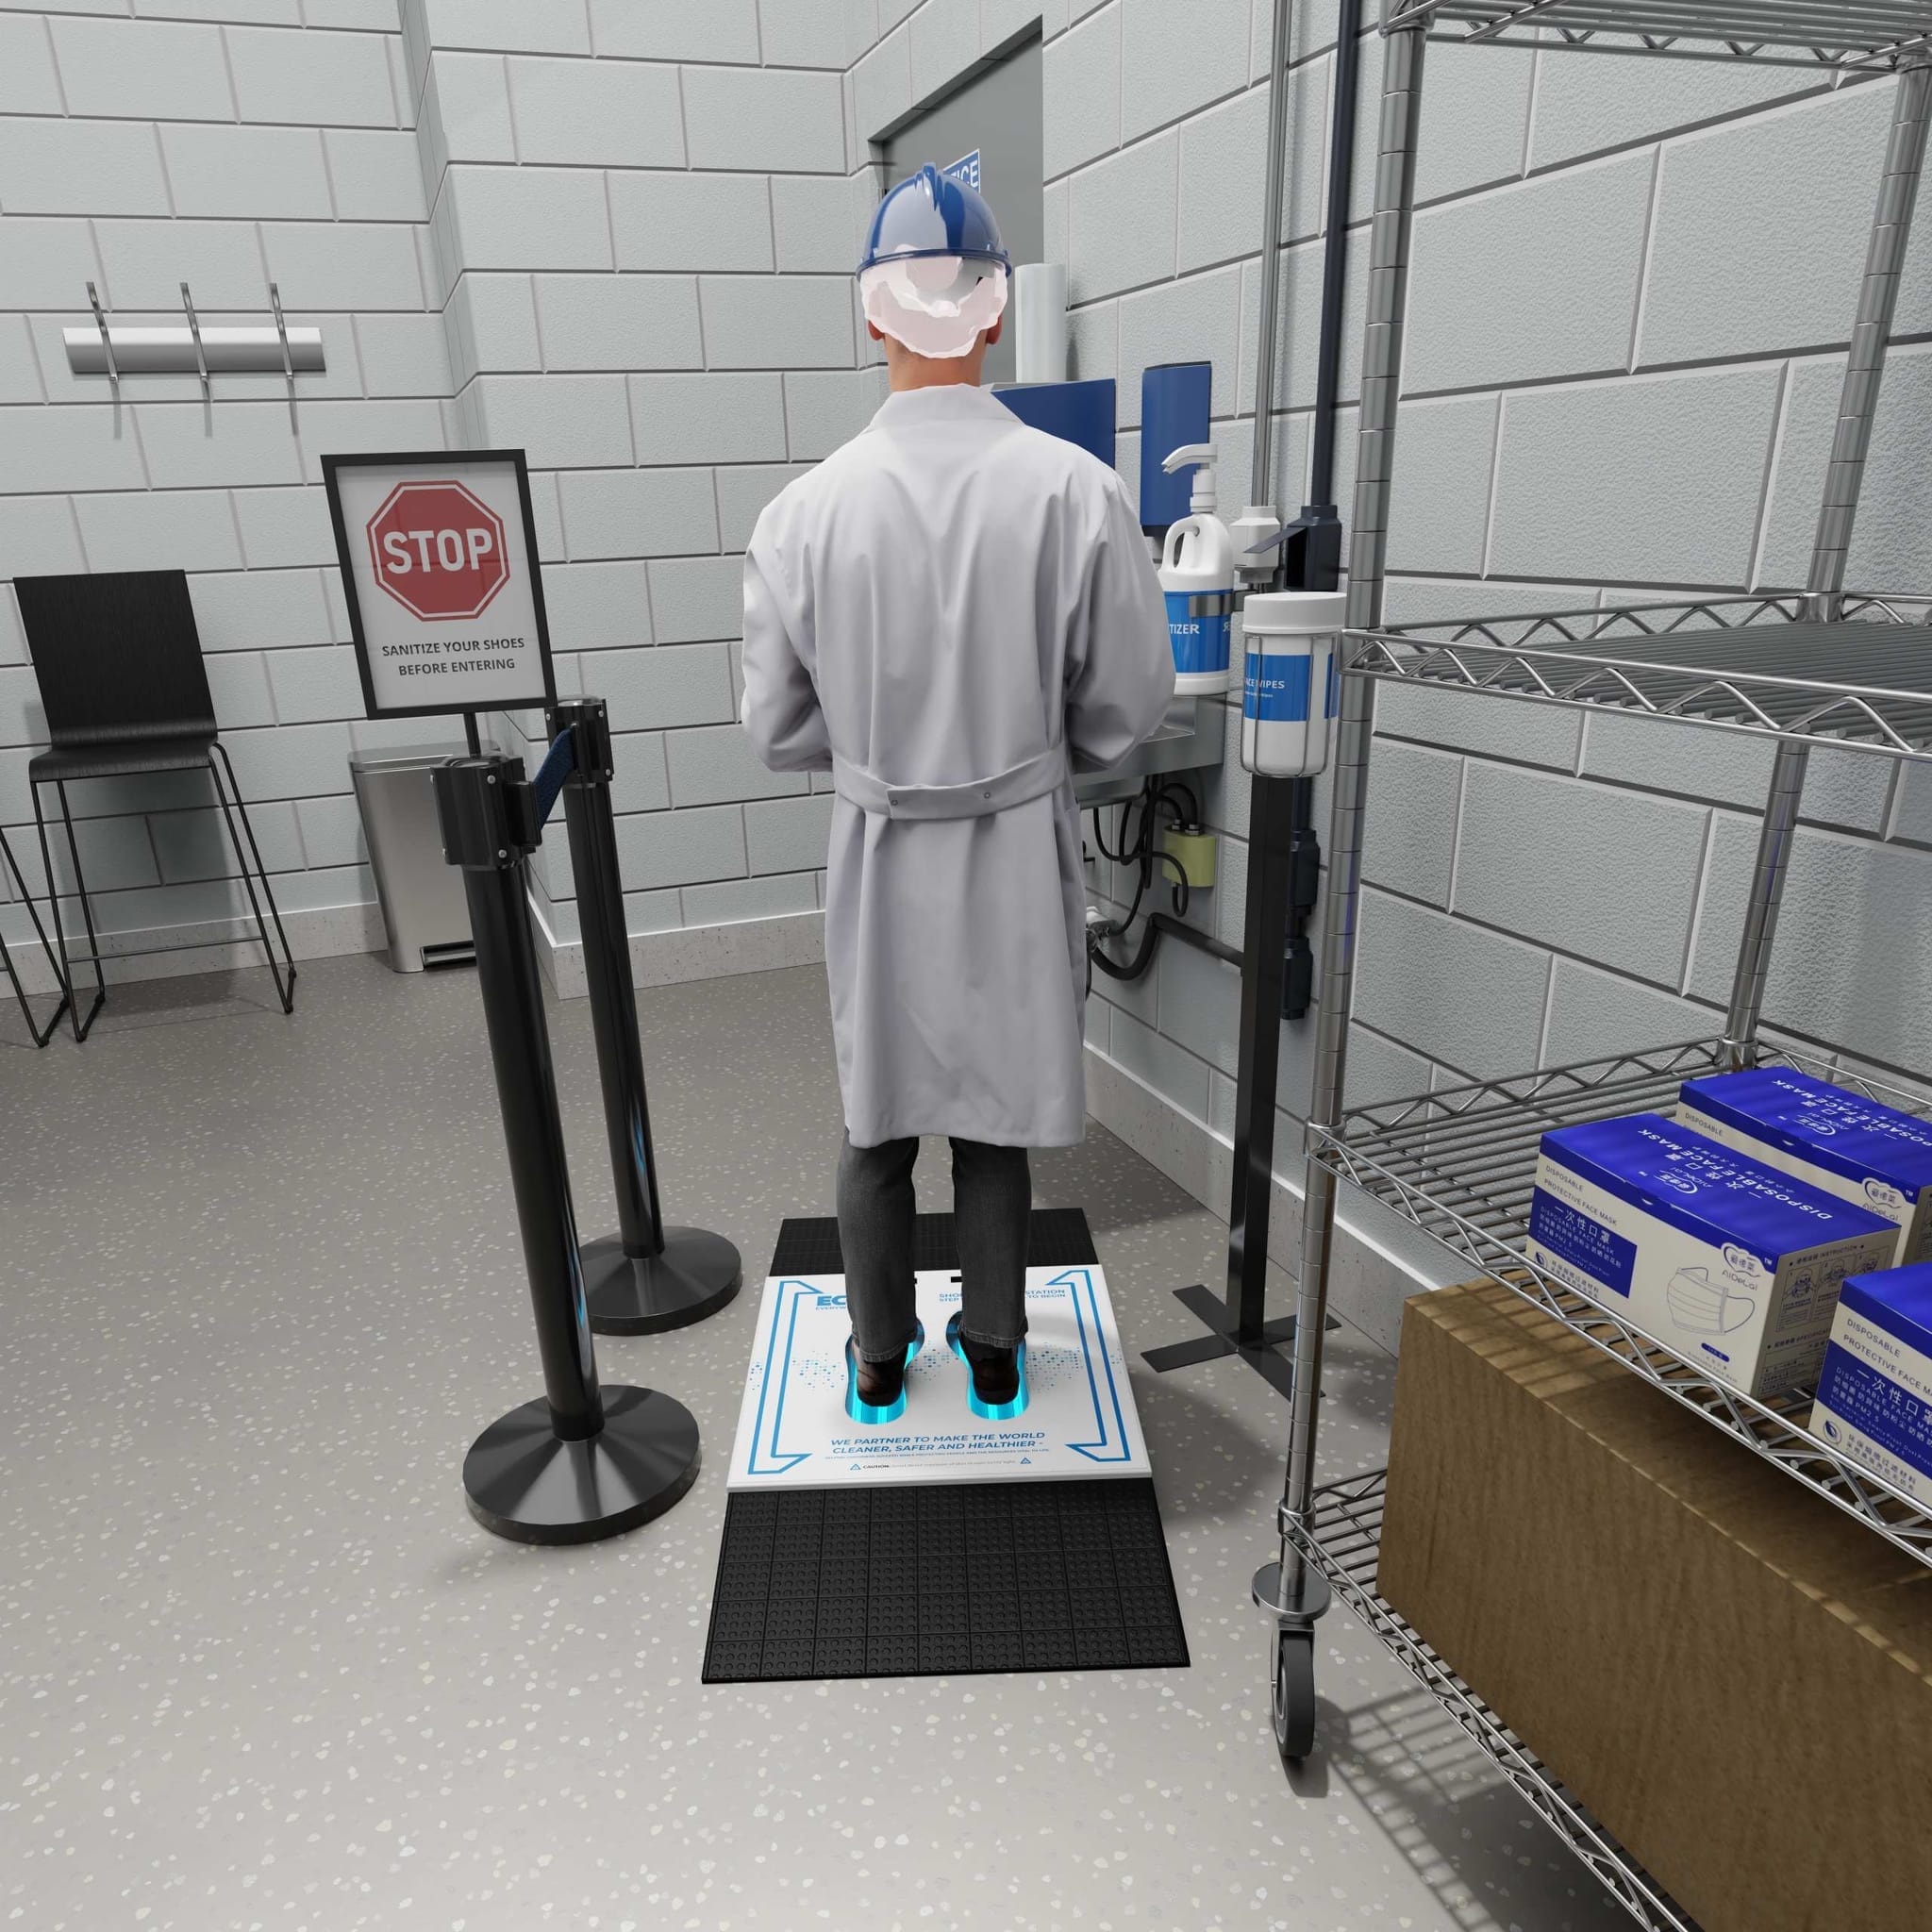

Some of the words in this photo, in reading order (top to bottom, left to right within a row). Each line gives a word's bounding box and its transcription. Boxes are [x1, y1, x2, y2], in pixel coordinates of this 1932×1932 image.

[383, 528, 492, 574] STOP
[1169, 624, 1200, 634] TIZER
[382, 642, 441, 657] SANITIZE
[442, 641, 480, 653] YOUR
[484, 638, 525, 650] SHOES
[399, 662, 447, 675] BEFORE
[452, 658, 515, 672] ENTERING
[1772, 1080, 1816, 1098] MASK
[1812, 1098, 1860, 1115] FACE
[1685, 1113, 1724, 1137] DISPOSABLE
[1857, 1114, 1932, 1145] POSABLE
[1638, 1128, 1682, 1150] MASK
[1680, 1150, 1724, 1169] FACE
[1545, 1165, 1583, 1191] DISPOSABLE
[1665, 1153, 1761, 1198] 一次性口罩
[1544, 1178, 1582, 1205] PROTECTIVE
[1581, 1200, 1597, 1214] FACE
[1599, 1209, 1617, 1224] MASK
[1722, 1170, 1832, 1219] DISPOSABLE
[1540, 1207, 1576, 1231] DISPOSABLE
[1579, 1230, 1593, 1242] FACE
[1597, 1241, 1613, 1254] MASK
[1555, 1207, 1609, 1244] 一次性口罩
[817, 1295, 847, 1306] EC
[1847, 1319, 1901, 1357] DISPOSABLE
[1843, 1334, 1896, 1372] PROTECTIVE
[1897, 1368, 1921, 1389] FACE
[1922, 1384, 1932, 1396] MA
[1835, 1367, 1887, 1406] DISPOSABLE
[1890, 1405, 1911, 1422] FACE
[1916, 1421, 1932, 1435] MAS
[854, 1437, 911, 1445] PARTNER
[969, 1441, 1036, 1449] HEALTHIER
